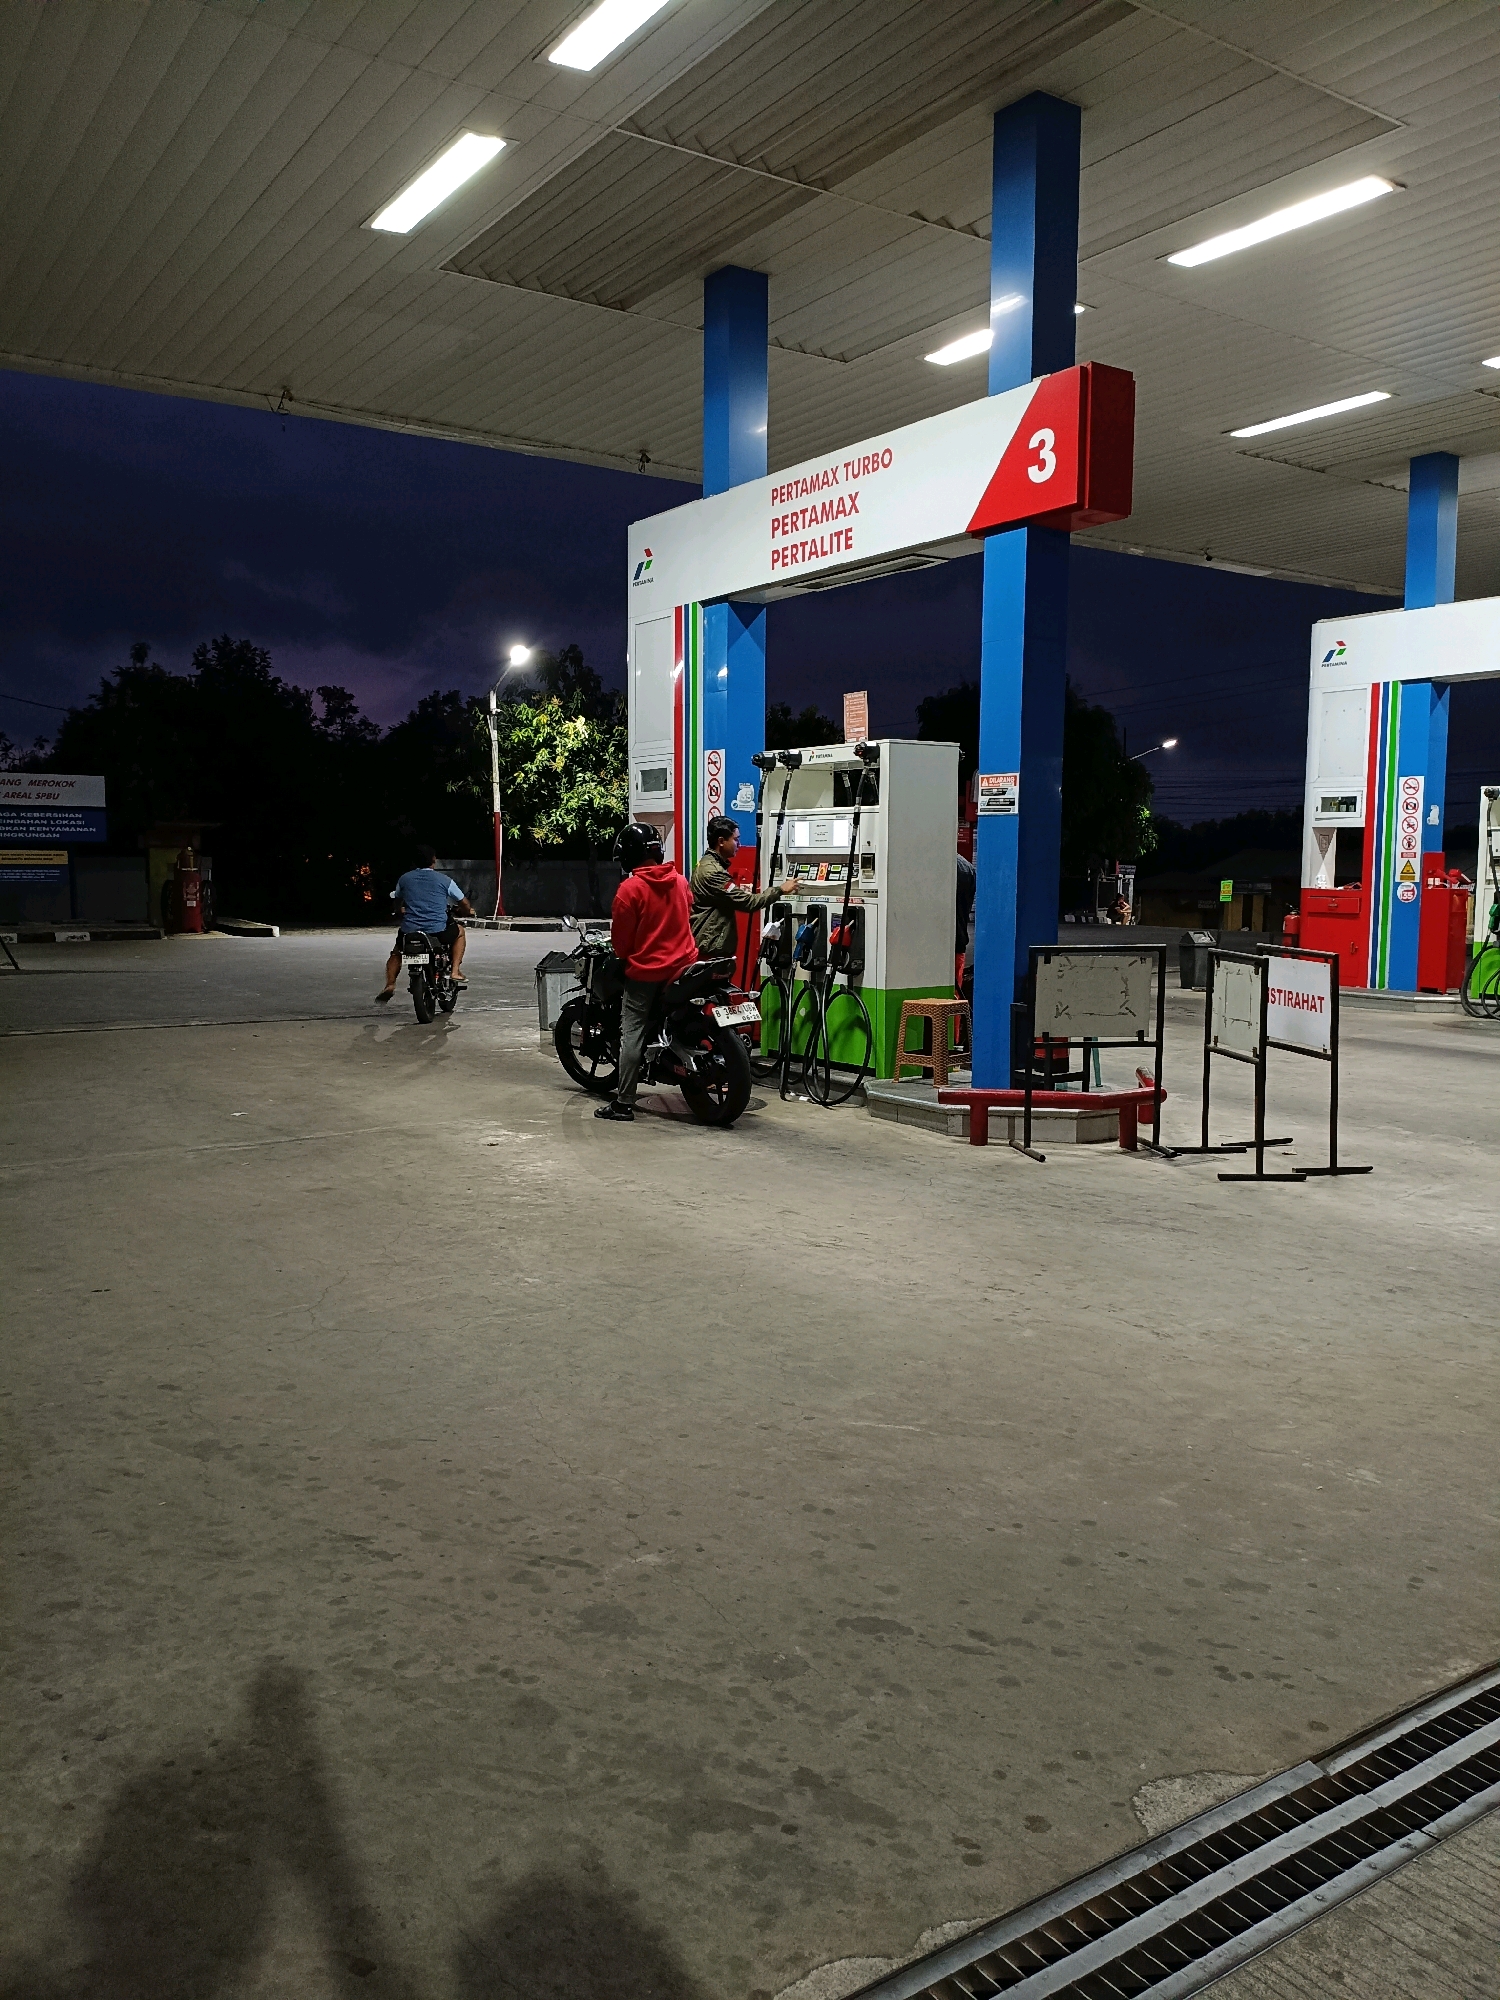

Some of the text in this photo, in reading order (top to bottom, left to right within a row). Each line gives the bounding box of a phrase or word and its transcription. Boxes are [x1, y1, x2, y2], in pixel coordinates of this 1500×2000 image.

[771, 447, 893, 507] PERTAMAX TURBO
[1027, 427, 1057, 484] 3
[771, 491, 860, 540] PERTAMAX
[771, 527, 853, 571] PERTALITE
[2, 791, 60, 800] AREAL SPBU
[27, 779, 76, 788] MEROKOK
